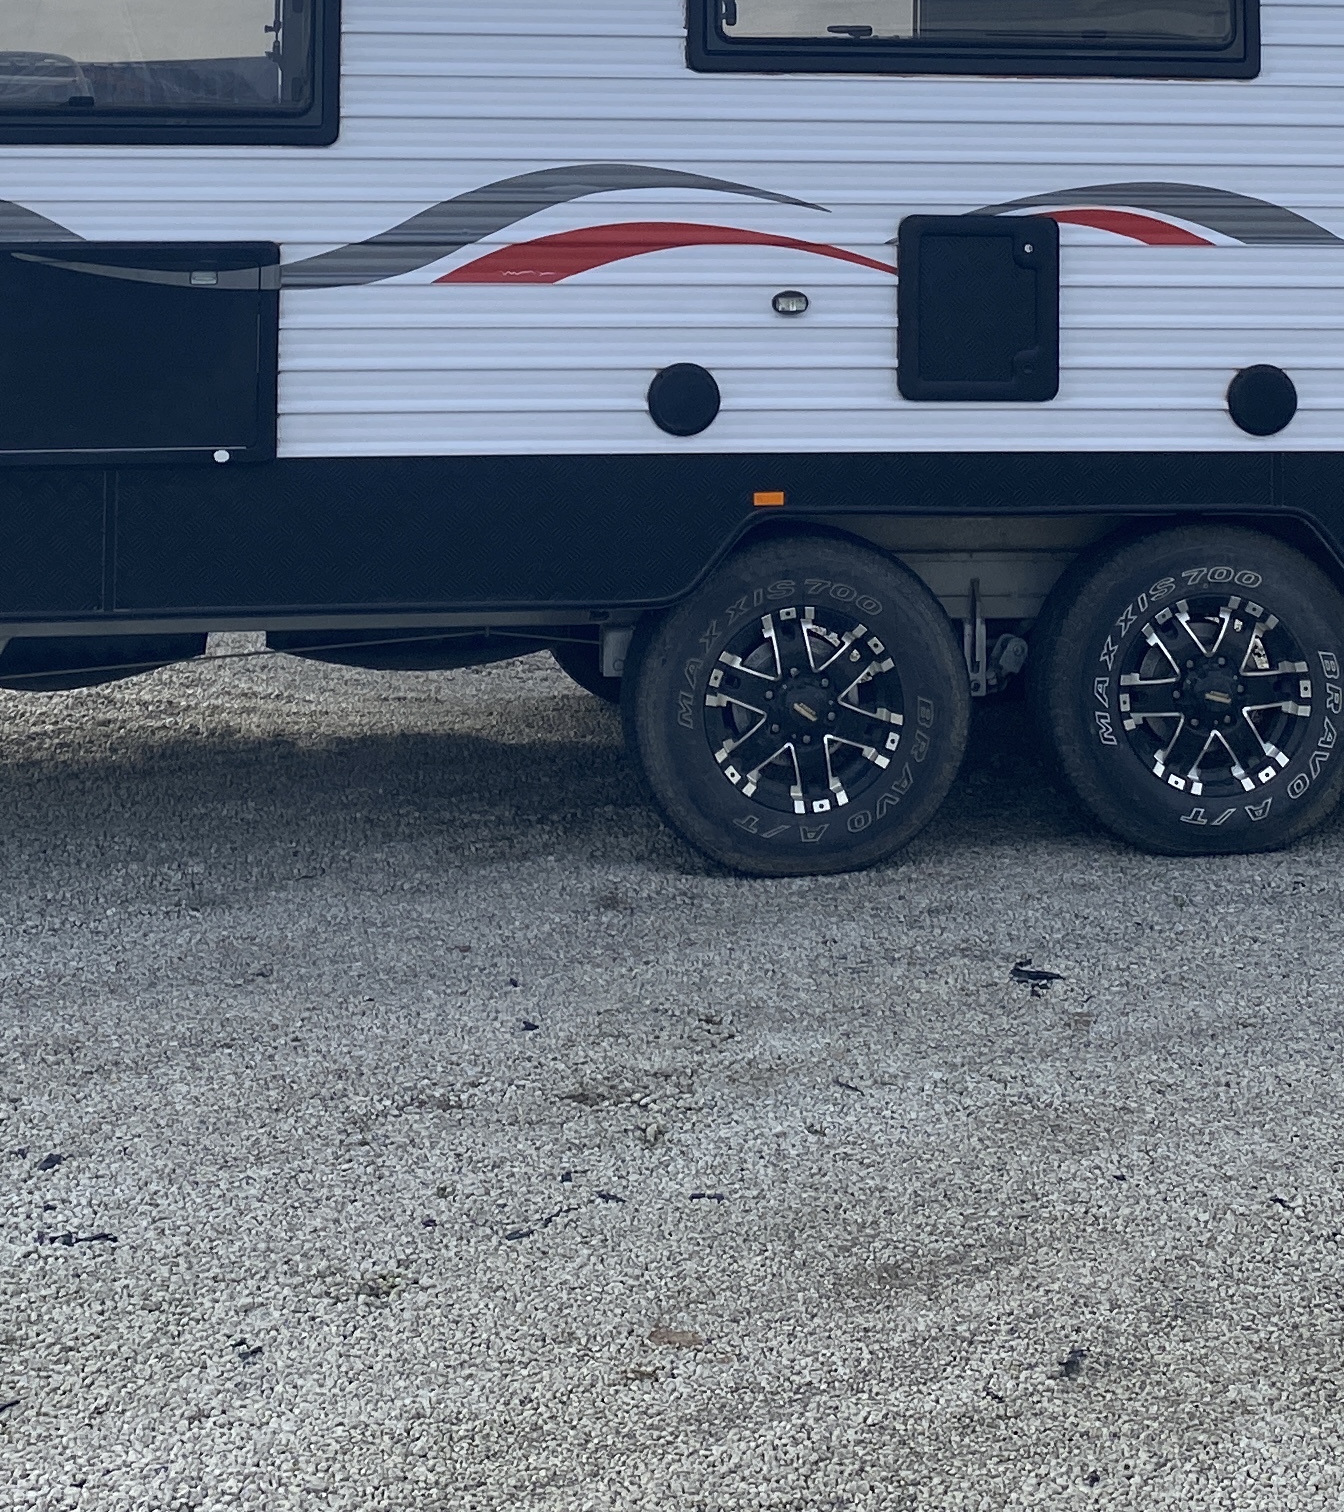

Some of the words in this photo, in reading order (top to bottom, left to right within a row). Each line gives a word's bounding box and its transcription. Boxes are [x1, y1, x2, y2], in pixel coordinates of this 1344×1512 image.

[678, 579, 796, 729] MAXXIS
[805, 579, 883, 615] 700
[1094, 577, 1176, 745] MAXXIS
[1182, 566, 1262, 588] 700
[1287, 651, 1342, 799] BRAVO
[733, 815, 830, 842] A/T
[847, 696, 934, 833] BRAVO
[1180, 797, 1273, 825] A/T
